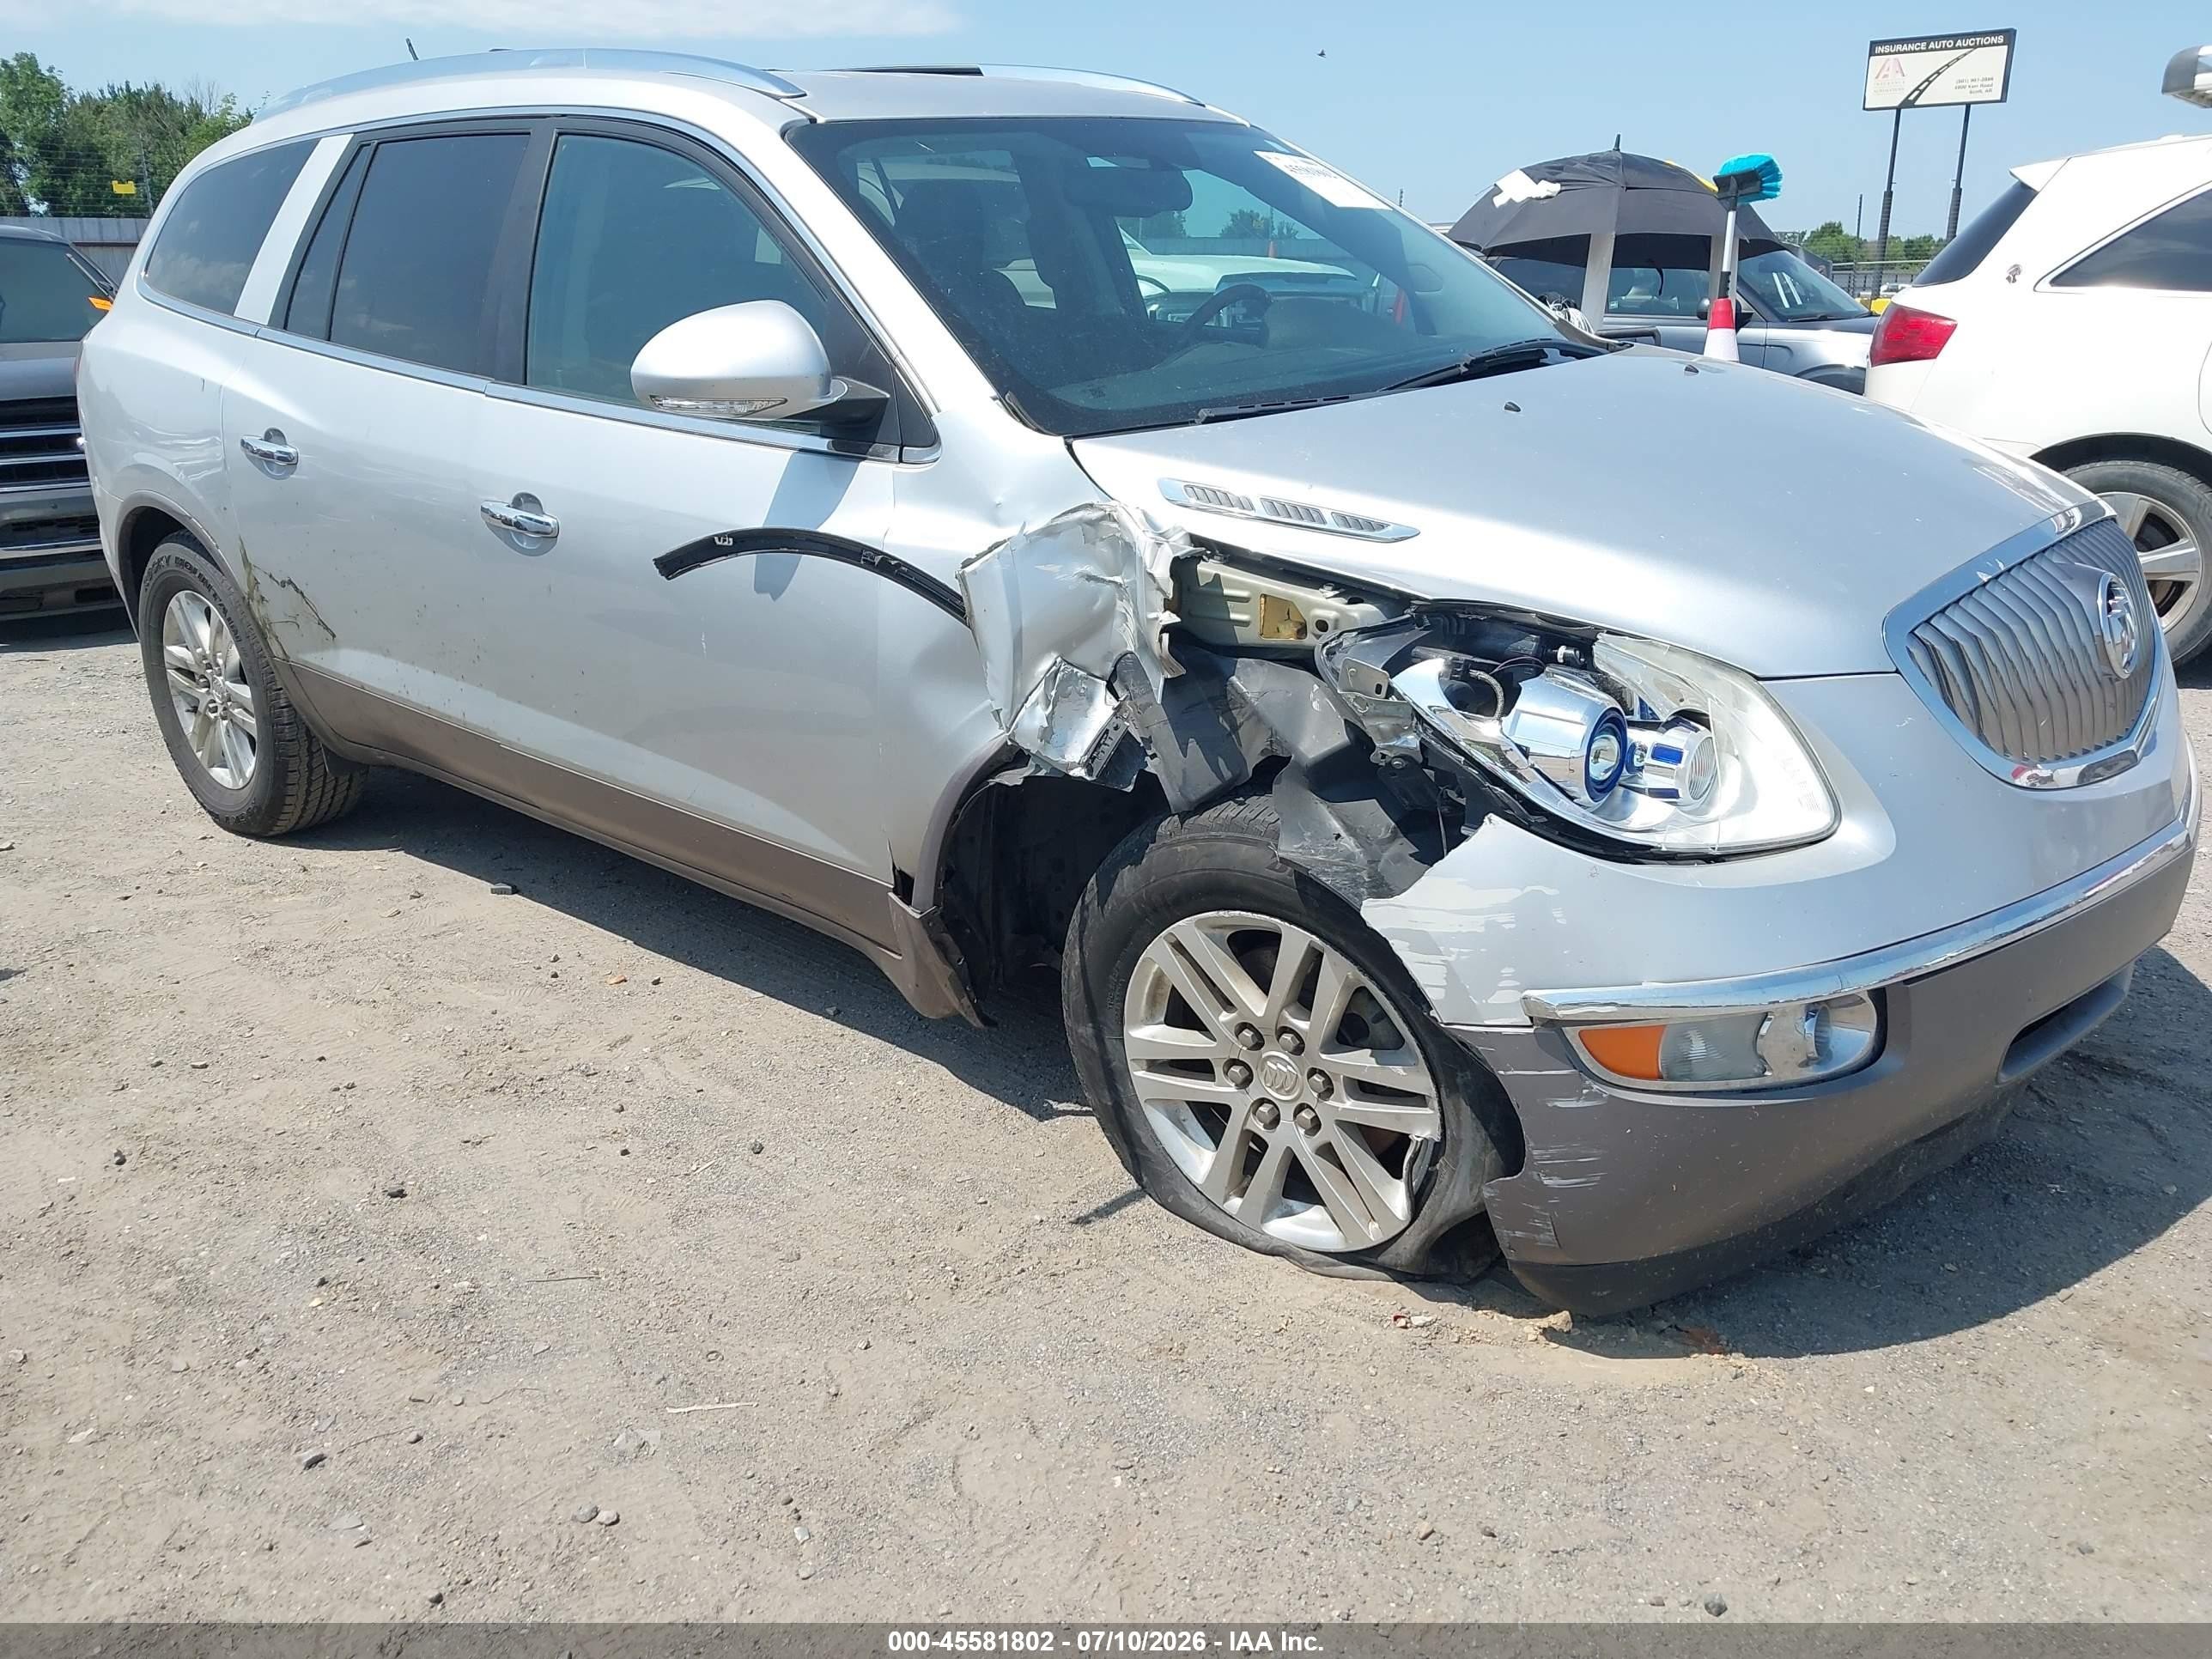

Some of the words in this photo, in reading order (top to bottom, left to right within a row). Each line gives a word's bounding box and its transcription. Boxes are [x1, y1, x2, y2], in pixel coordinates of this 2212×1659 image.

[1875, 42, 1927, 54] INSURANCE
[1929, 40, 1954, 50] AUTO
[1955, 35, 2004, 47] AUCTIONS
